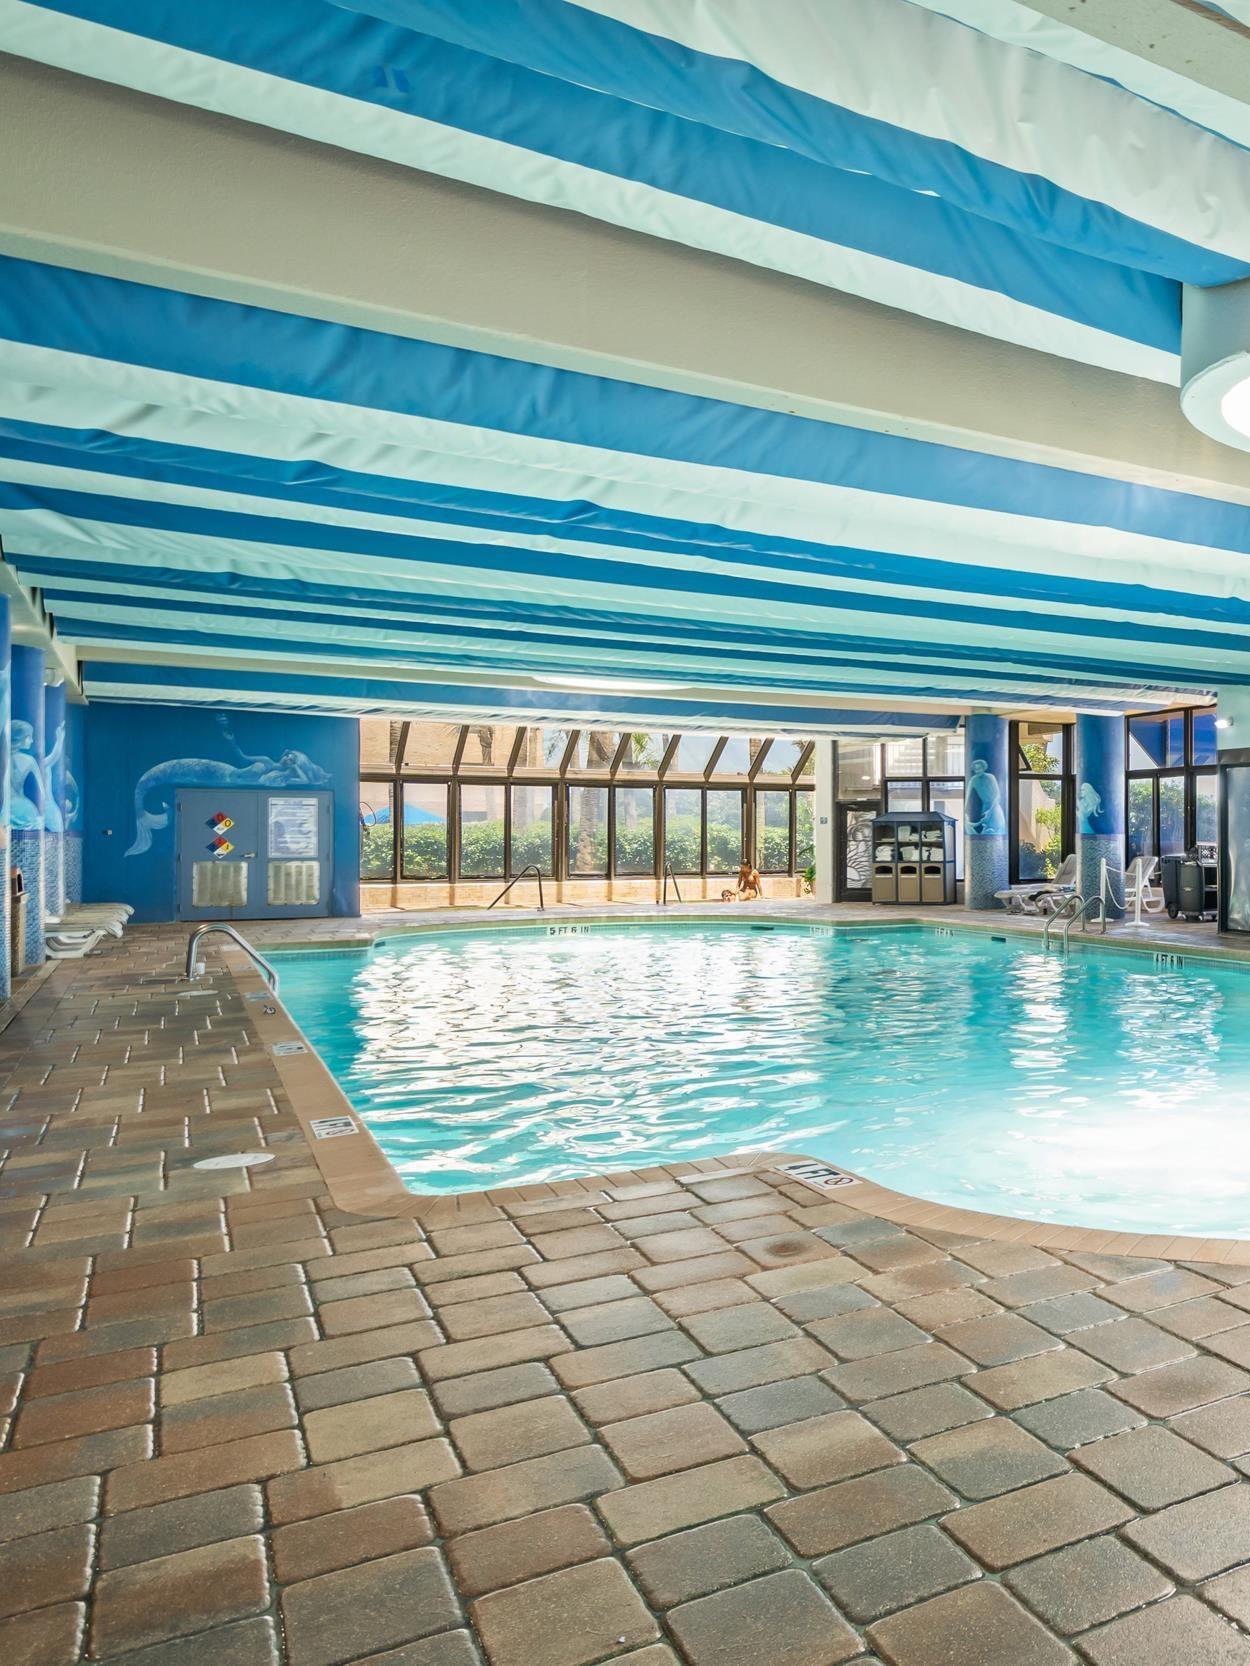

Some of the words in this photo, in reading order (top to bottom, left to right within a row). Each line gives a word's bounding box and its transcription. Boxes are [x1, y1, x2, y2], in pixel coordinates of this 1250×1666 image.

[550, 927, 556, 935] 5
[558, 927, 568, 935] FT
[795, 1168, 841, 1180] FT
